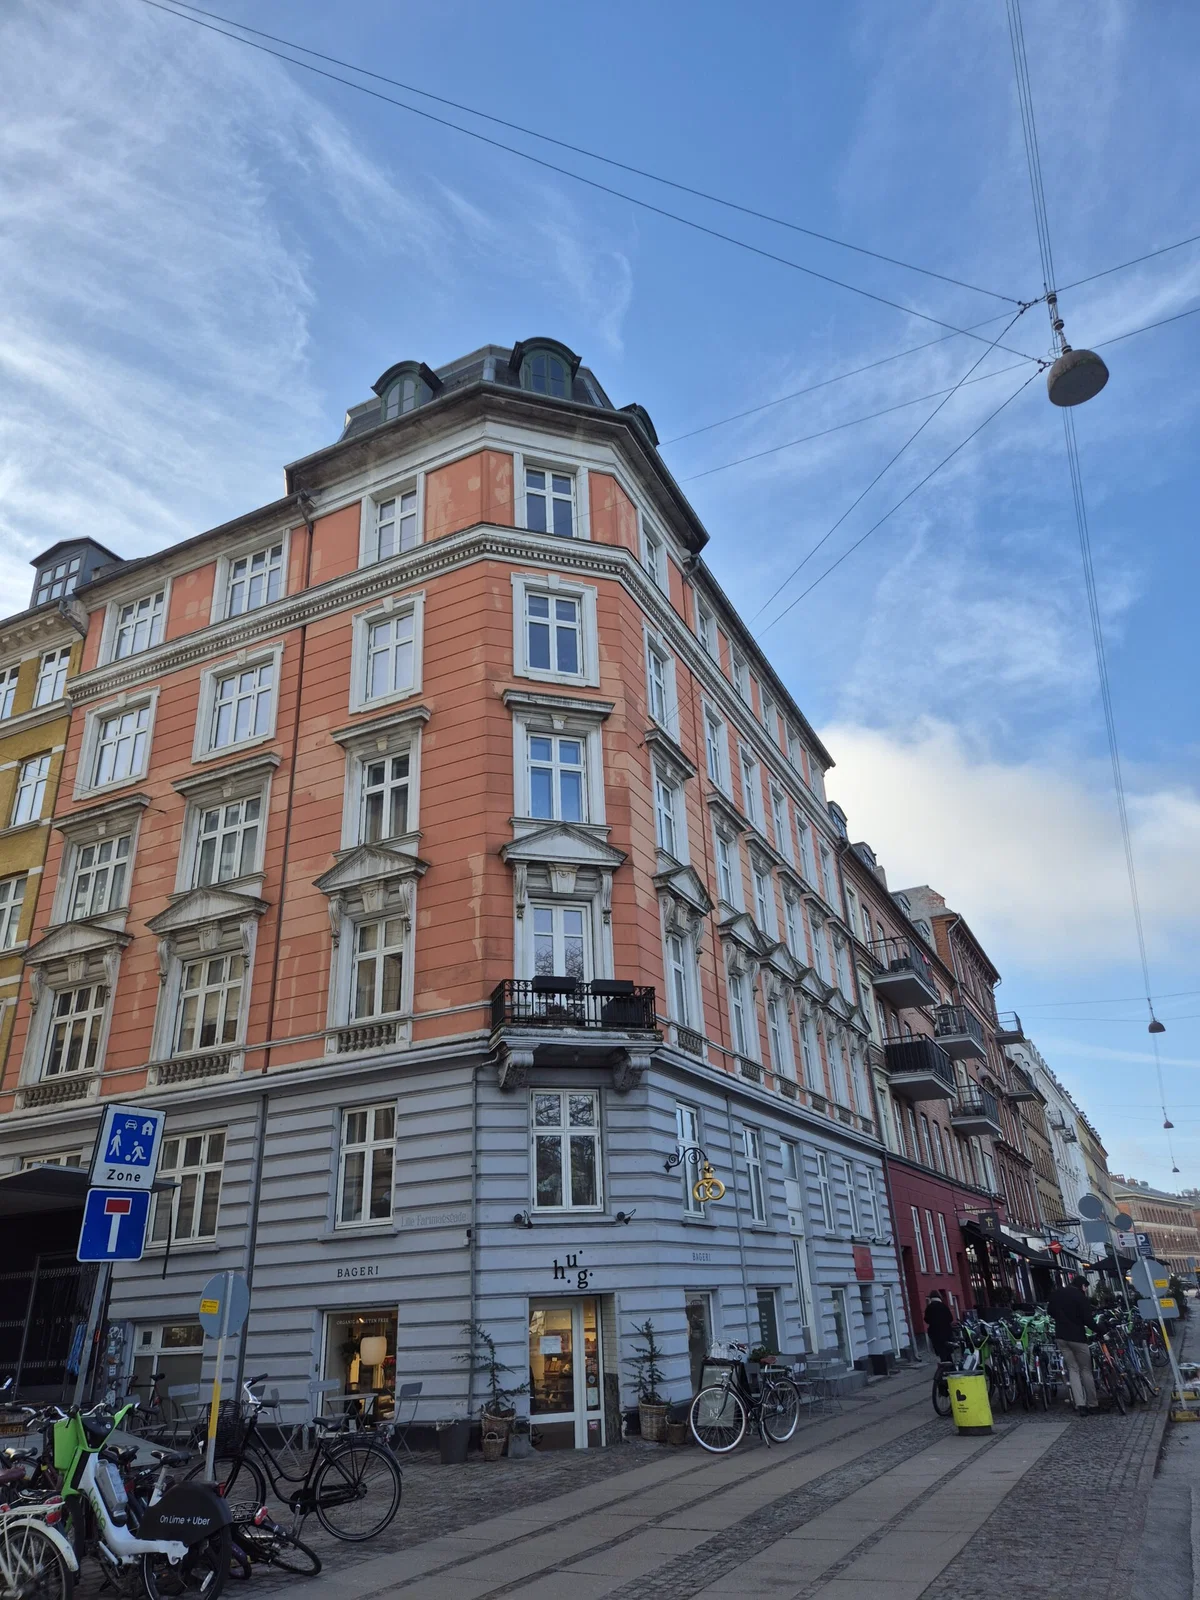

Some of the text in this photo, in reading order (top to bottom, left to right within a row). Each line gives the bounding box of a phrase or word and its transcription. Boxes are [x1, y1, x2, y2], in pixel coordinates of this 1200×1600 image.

[106, 1168, 141, 1182] Zone
[1136, 1234, 1146, 1246] P
[692, 1252, 712, 1262] BAGERI
[336, 1265, 379, 1278] BAGERI
[160, 1514, 168, 1524] On
[168, 1514, 185, 1525] Lime
[192, 1516, 210, 1526] Uber
